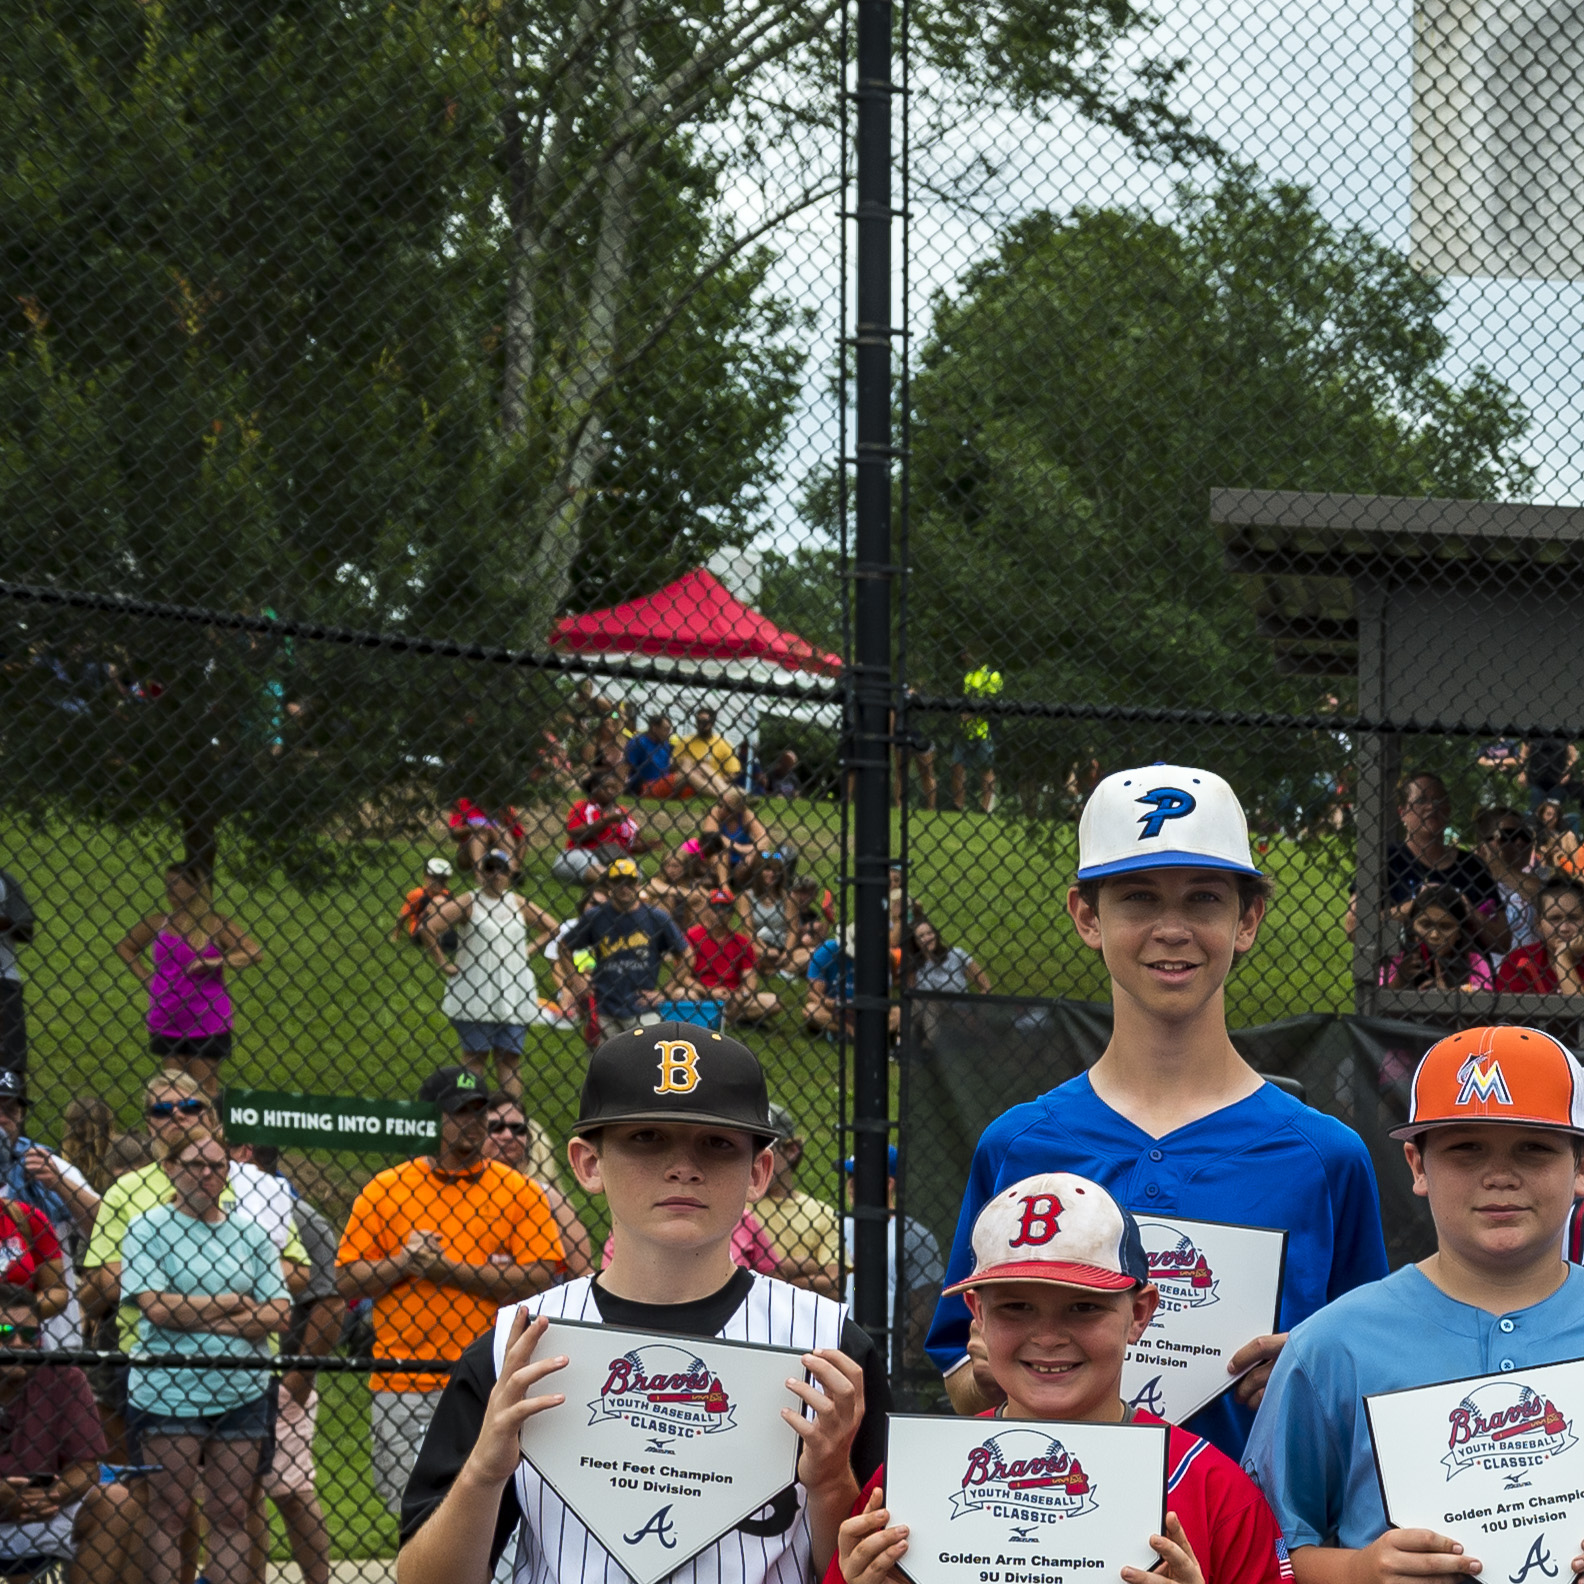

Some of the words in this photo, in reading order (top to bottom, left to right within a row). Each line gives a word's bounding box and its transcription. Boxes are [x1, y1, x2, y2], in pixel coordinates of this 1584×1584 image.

[1134, 786, 1197, 842] P
[653, 1039, 702, 1093] B
[1455, 1056, 1514, 1106] M
[230, 1107, 259, 1126] NO
[263, 1109, 333, 1131] HITTING
[338, 1114, 381, 1134] INTO
[386, 1118, 437, 1138] FENCE
[1009, 1194, 1066, 1248] B
[1136, 1353, 1188, 1368] Division
[1156, 1340, 1221, 1356] Champion
[601, 1358, 710, 1396] Braves
[631, 1416, 694, 1438] CLASSIC
[1449, 1395, 1542, 1448] Braves
[580, 1456, 618, 1471] Fleet
[622, 1461, 655, 1475] Feet
[660, 1466, 733, 1484] Champion
[962, 1447, 1068, 1488] Braves
[609, 1476, 639, 1490] 10U
[643, 1481, 702, 1497] Division
[993, 1505, 1057, 1524] CLASSIC
[1444, 1506, 1492, 1524] Golden
[1497, 1501, 1525, 1513] Arm
[1481, 1521, 1508, 1533] 10U
[1512, 1510, 1567, 1528] Division
[939, 1552, 991, 1566] Golden
[995, 1555, 1026, 1567] Arm
[1031, 1557, 1104, 1569] Champion
[980, 1572, 1000, 1583] 9U
[1004, 1573, 1063, 1584] Division
